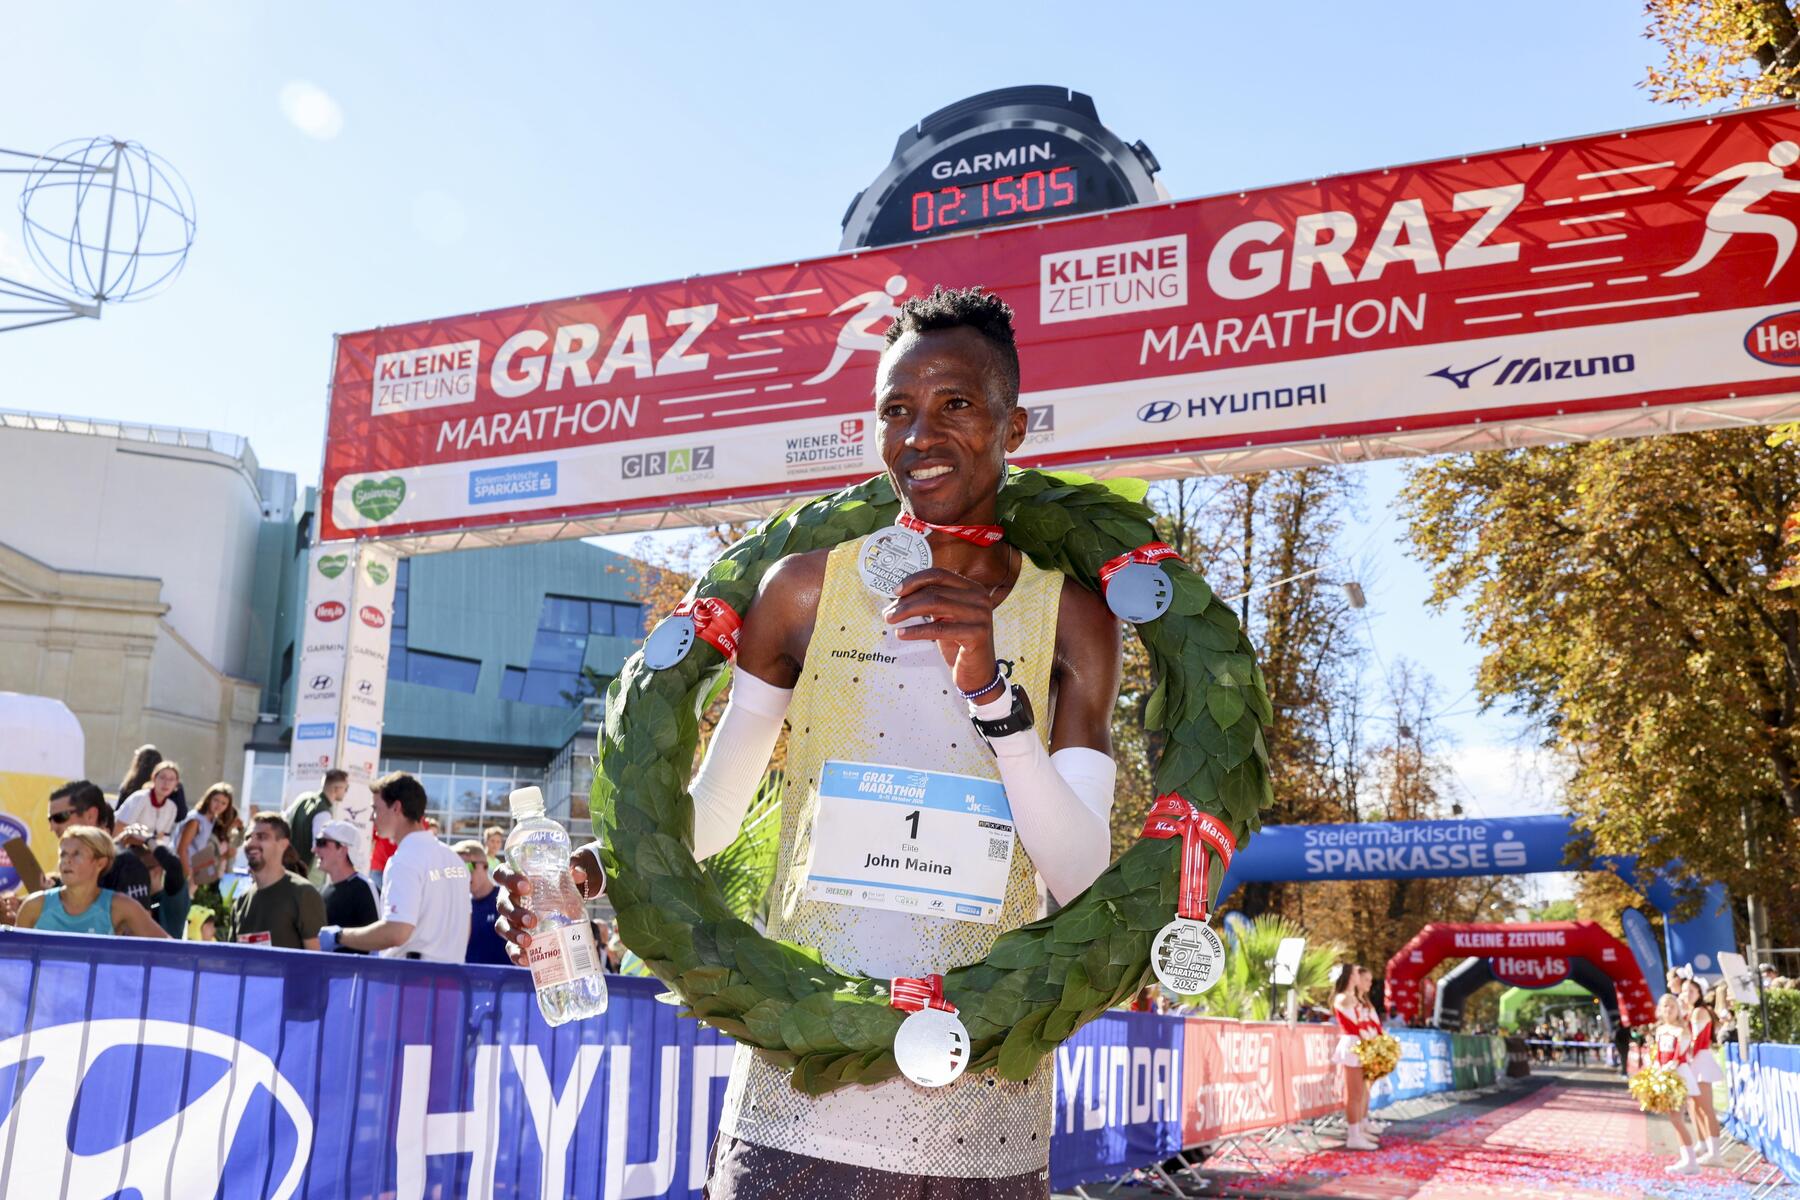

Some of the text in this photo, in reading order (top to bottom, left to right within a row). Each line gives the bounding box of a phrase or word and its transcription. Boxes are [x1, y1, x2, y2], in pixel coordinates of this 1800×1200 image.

[931, 142, 1051, 180] GARMIN
[911, 165, 1075, 232] 02:15:05
[1206, 183, 1525, 300] GRAZ
[1049, 245, 1178, 285] KLEINE
[1048, 273, 1178, 314] ZEITUNG
[1139, 292, 1427, 366] MARATHON
[490, 303, 719, 398] GRAZ
[380, 350, 473, 381] KLEINE
[1493, 353, 1635, 386] MIZUNO
[377, 374, 471, 407] ZEITUNG
[1188, 383, 1326, 418] HYUNDAI
[436, 395, 641, 452] MARATHON
[786, 434, 838, 450] WIENER
[623, 448, 710, 477] GRAZ
[474, 479, 539, 498] SPARKASSE
[1144, 547, 1178, 557] Mara
[869, 566, 903, 584] MARATHO
[892, 568, 909, 579] GRA
[831, 649, 897, 664] run2gether
[858, 782, 926, 799] MARATHON
[862, 771, 895, 784] GRAZ
[905, 810, 920, 839] 1
[1304, 824, 1487, 847] Steiermärkische
[901, 843, 919, 853] Elite
[1304, 842, 1490, 873] SPARKASSE
[864, 853, 952, 875] John Maina
[1454, 931, 1567, 948] KLEINE ZEITUNG
[1164, 966, 1209, 981] MARATHON
[1189, 963, 1211, 973] GRAZ
[1499, 957, 1567, 980] Hervis
[1173, 977, 1198, 991] 2026
[1051, 1045, 1179, 1137] YUNDAI
